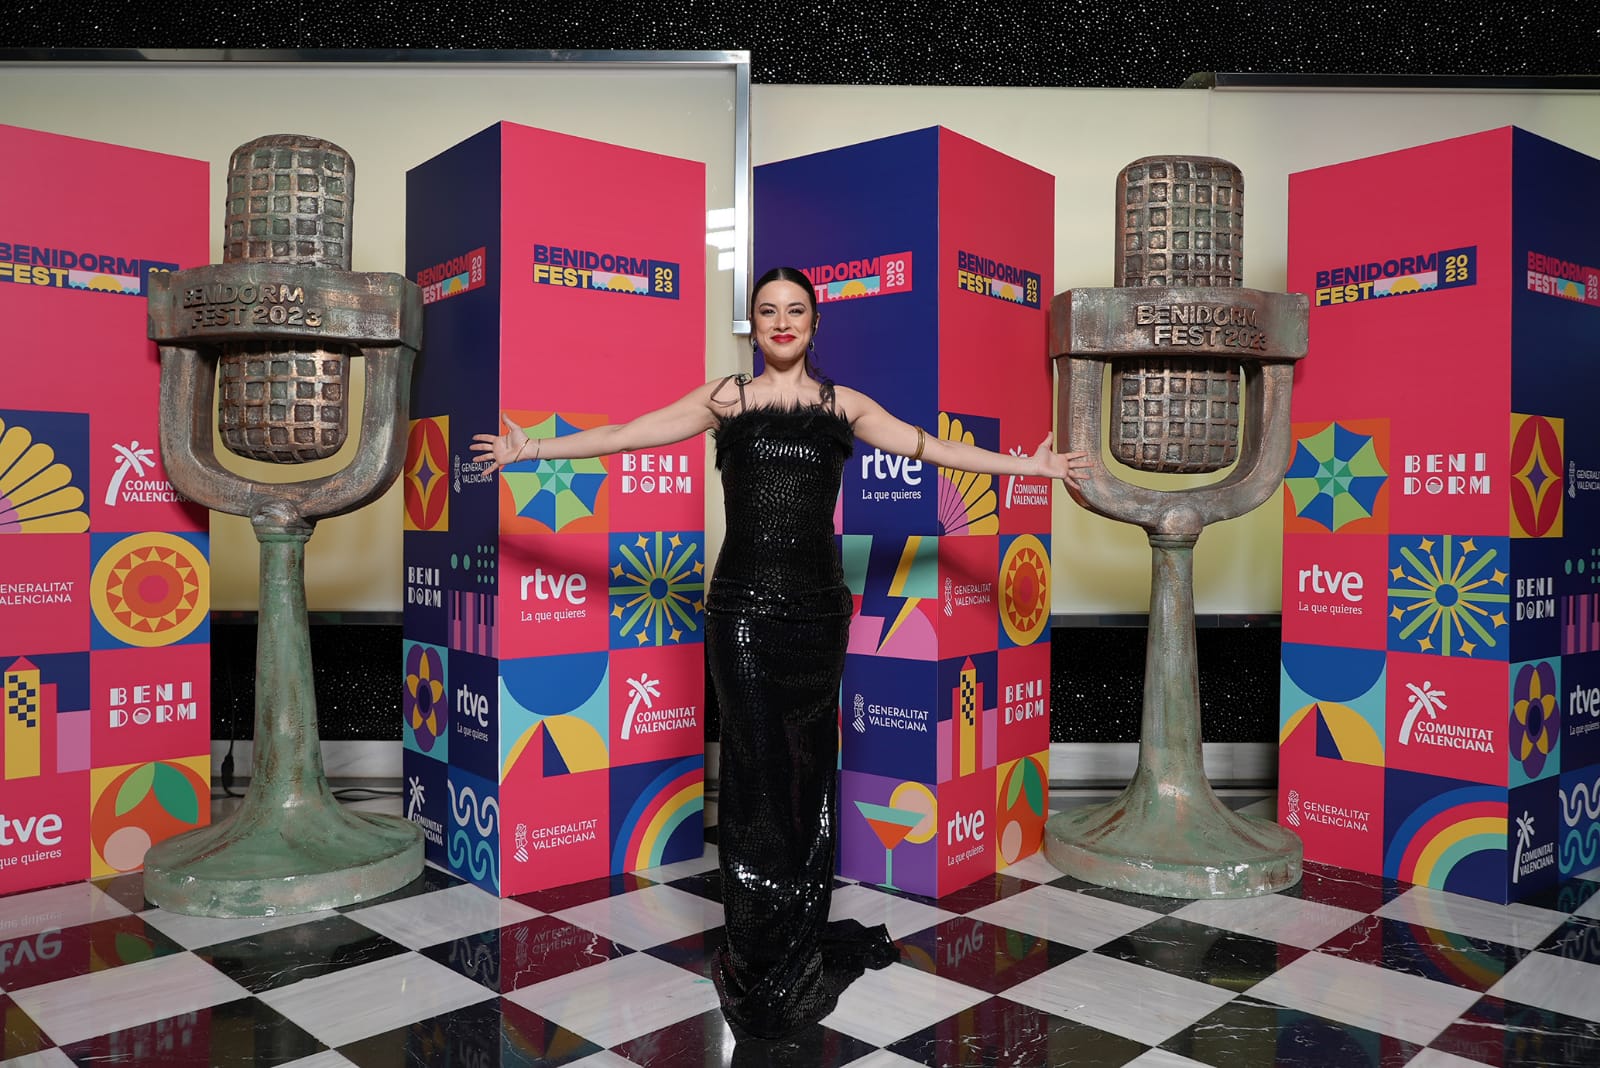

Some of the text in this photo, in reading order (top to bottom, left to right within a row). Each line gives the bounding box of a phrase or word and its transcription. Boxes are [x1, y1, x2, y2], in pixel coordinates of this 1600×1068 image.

[0, 242, 140, 277] BENIDORM
[472, 255, 482, 270] 20
[533, 244, 648, 277] BENIDORM
[886, 260, 904, 275] 20
[958, 250, 1024, 285] BENIDORM
[1445, 254, 1468, 269] 20
[1528, 251, 1583, 283] BENIDORM
[417, 254, 469, 287] BENIDORM
[472, 268, 482, 283] 23
[533, 263, 592, 289] FEST
[654, 267, 672, 280] 20
[800, 257, 880, 285] NIDORM
[1315, 252, 1437, 288] BENIDORM
[1445, 268, 1468, 283] 23
[654, 280, 673, 293] 23
[886, 273, 905, 288] 23
[958, 269, 993, 296] FEST
[1026, 277, 1037, 291] 20
[1528, 270, 1558, 295] FEST
[1588, 275, 1598, 287] 20
[184, 283, 304, 308] BENIDORM
[423, 281, 442, 305] EST
[1026, 289, 1037, 303] 23
[1315, 281, 1374, 307] FEST
[1588, 287, 1598, 299] 23
[253, 305, 323, 327] 2023
[1137, 304, 1257, 328] BENIDORM
[1154, 325, 1221, 346] FEST
[622, 454, 688, 472] BENI
[862, 448, 922, 486] rtve
[1404, 453, 1486, 473] BENI
[125, 480, 174, 491] COMUN
[622, 475, 691, 494] DORM
[1015, 484, 1048, 494] COMUNITAT
[1404, 475, 1490, 495] DORM
[862, 489, 922, 502] La que quieres
[1013, 495, 1048, 505] VALENCIANA
[408, 566, 440, 586] BENI
[1299, 564, 1364, 601] rtve
[0, 582, 74, 593] ENERALITAT
[520, 568, 586, 605] rtve
[954, 582, 992, 595] GENERALITAT
[1517, 577, 1553, 598] BENI
[0, 593, 72, 605] ALENCIANA
[408, 586, 441, 608] DORM
[954, 594, 991, 607] VALENCIANA
[521, 608, 586, 623] La que quieres
[1299, 601, 1363, 615] La que quieres
[1517, 598, 1555, 621] DORM
[110, 681, 192, 706] BENI
[1005, 679, 1043, 705] BENI
[1570, 684, 1600, 717] rtve
[109, 702, 197, 728] DORM
[457, 684, 488, 727] rtve
[637, 706, 696, 723] COMUNITAT
[868, 703, 929, 721] GENERALITAT
[1005, 699, 1044, 725] DORM
[457, 723, 488, 742] La que quieres
[634, 717, 696, 735] VALENCIANA
[869, 715, 928, 733] VALENCIANA
[1417, 721, 1494, 741] COMUNITAT
[1414, 732, 1494, 754] VALENCIANA
[1303, 800, 1370, 821] GENERALITAT
[531, 819, 597, 839] GENERALITAT
[947, 810, 984, 845] rtve
[1304, 812, 1368, 832] VALENCIANA
[533, 831, 596, 850] VALENCIANA
[21, 849, 62, 866] quieres
[947, 845, 984, 866] La que quieres
[1521, 842, 1554, 864] COMUNITAT
[1520, 855, 1554, 876] VALENCIANA
